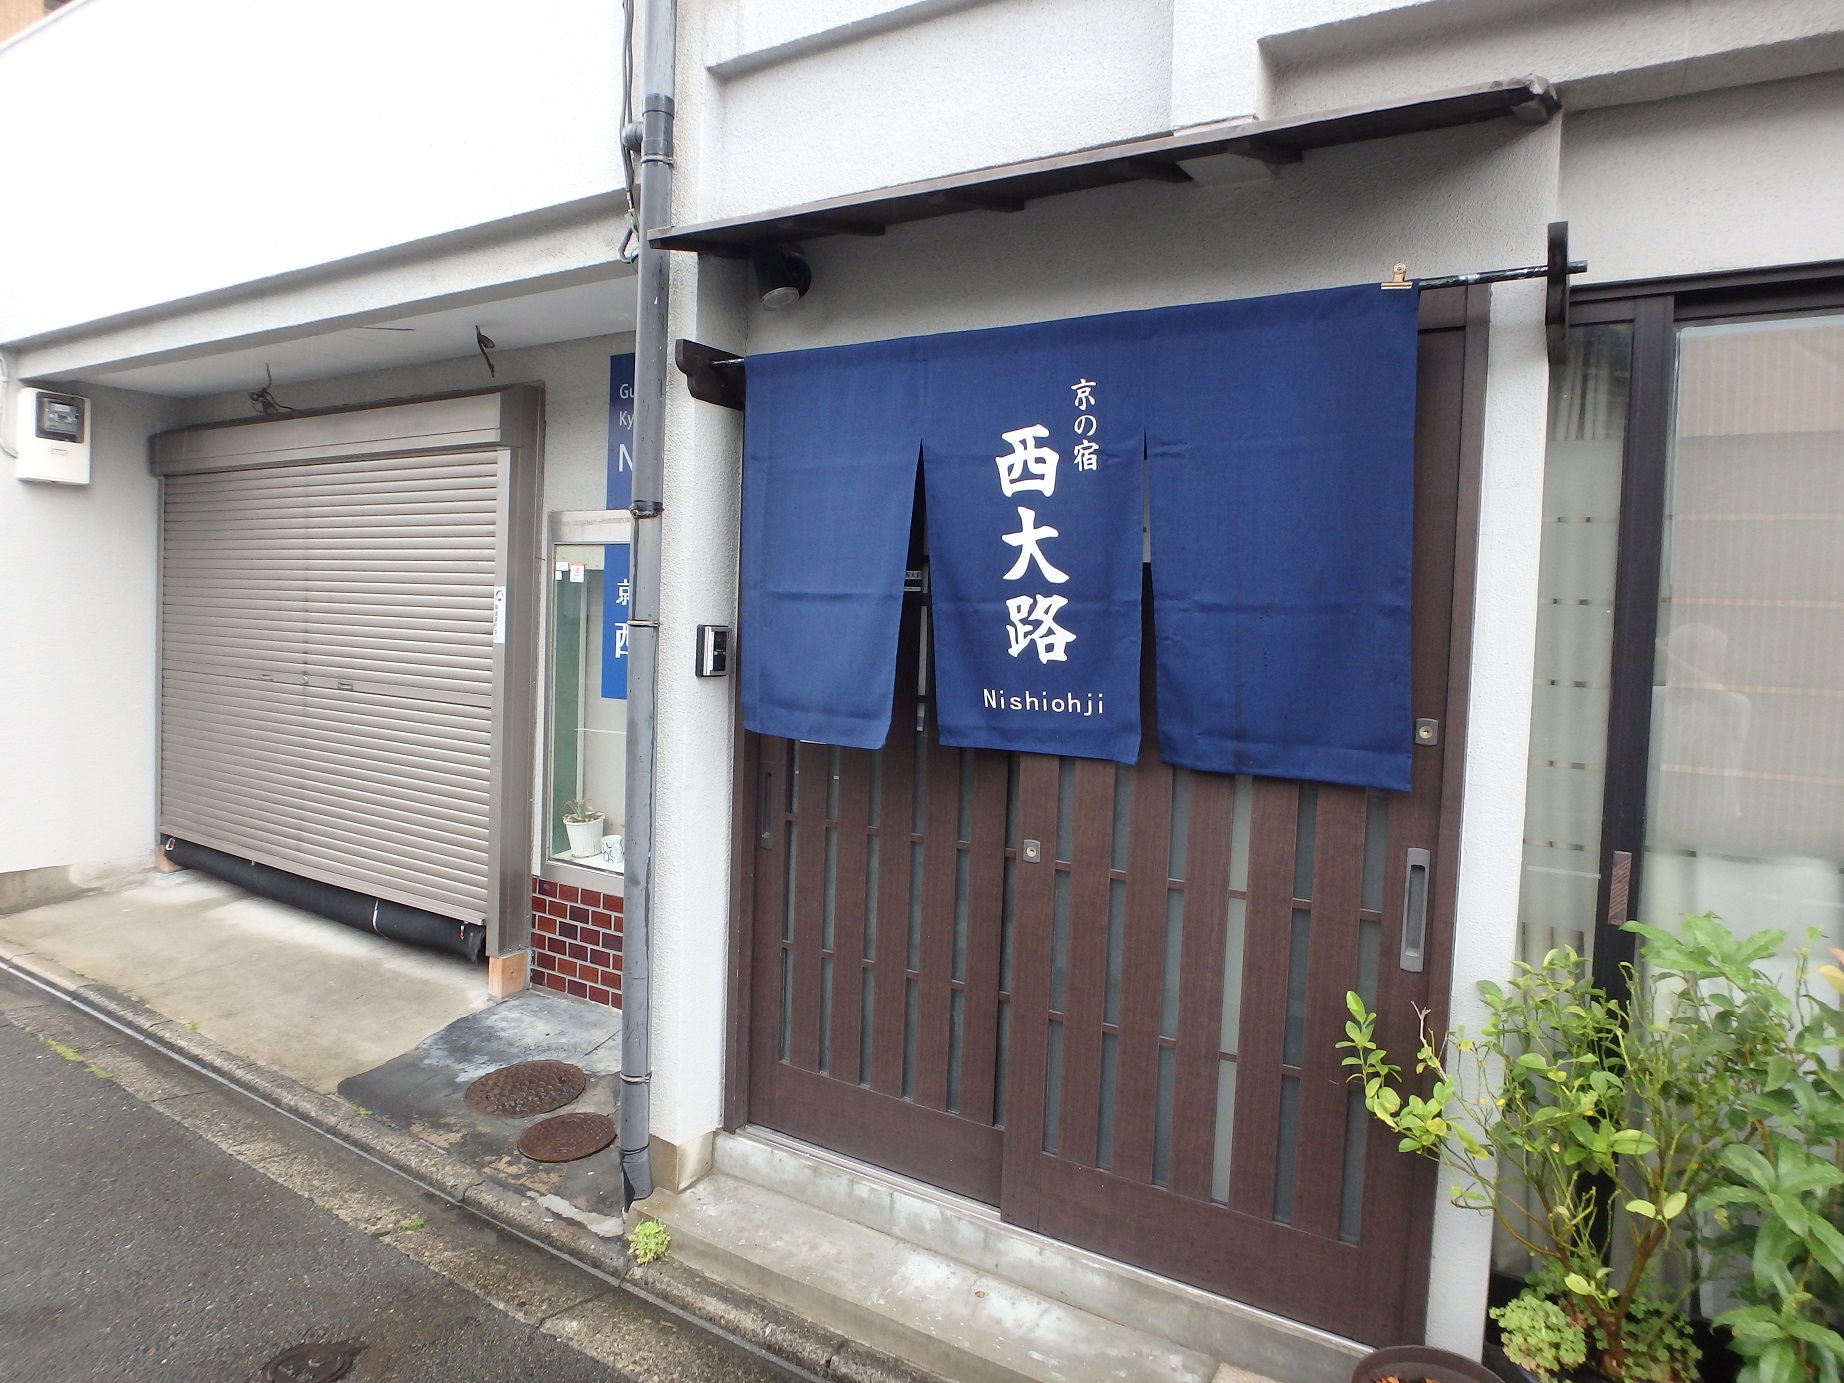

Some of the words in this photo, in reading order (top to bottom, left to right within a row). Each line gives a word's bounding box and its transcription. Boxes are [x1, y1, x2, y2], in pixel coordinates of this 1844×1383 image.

[1071, 378, 1100, 472] 京の宿
[995, 423, 1077, 665] 西大路
[984, 689, 1104, 716] Nishiohji
